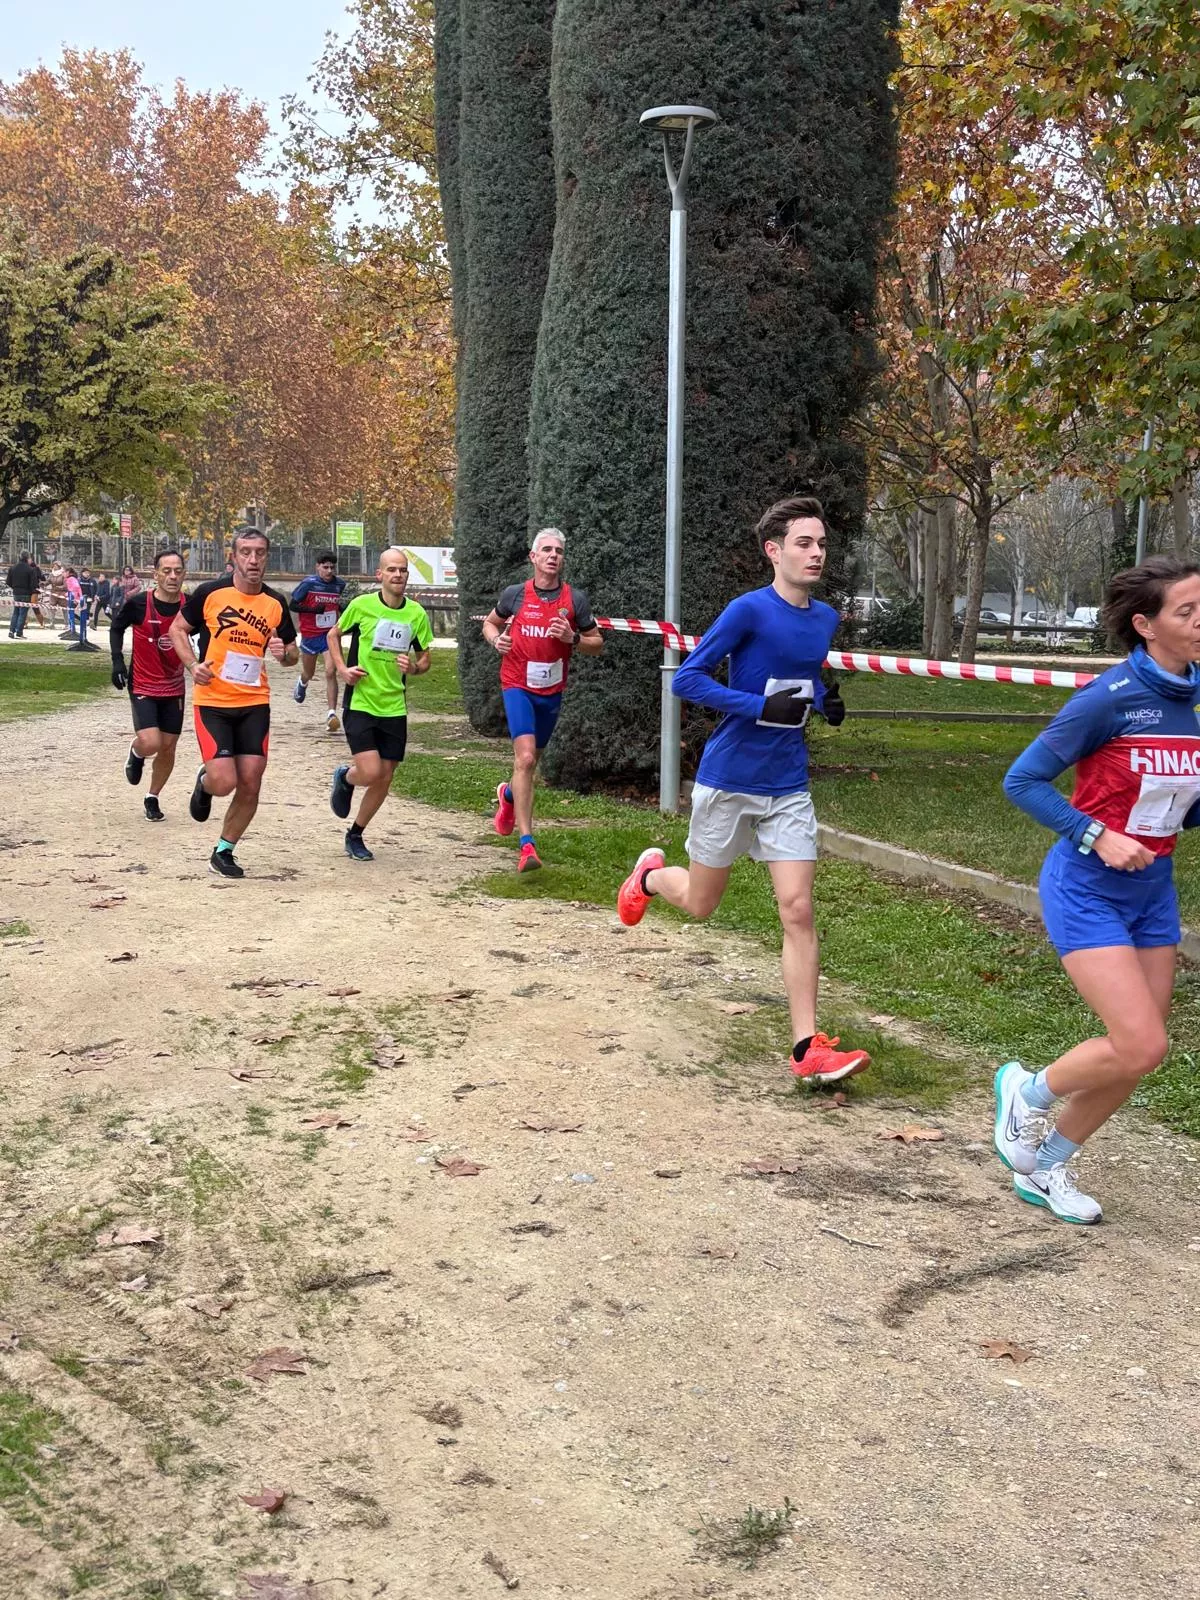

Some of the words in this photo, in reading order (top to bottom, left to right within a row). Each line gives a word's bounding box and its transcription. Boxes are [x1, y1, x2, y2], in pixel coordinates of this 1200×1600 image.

[230, 629, 249, 637] club
[390, 629, 402, 640] 16
[243, 664, 250, 673] 7
[542, 669, 552, 679] 21
